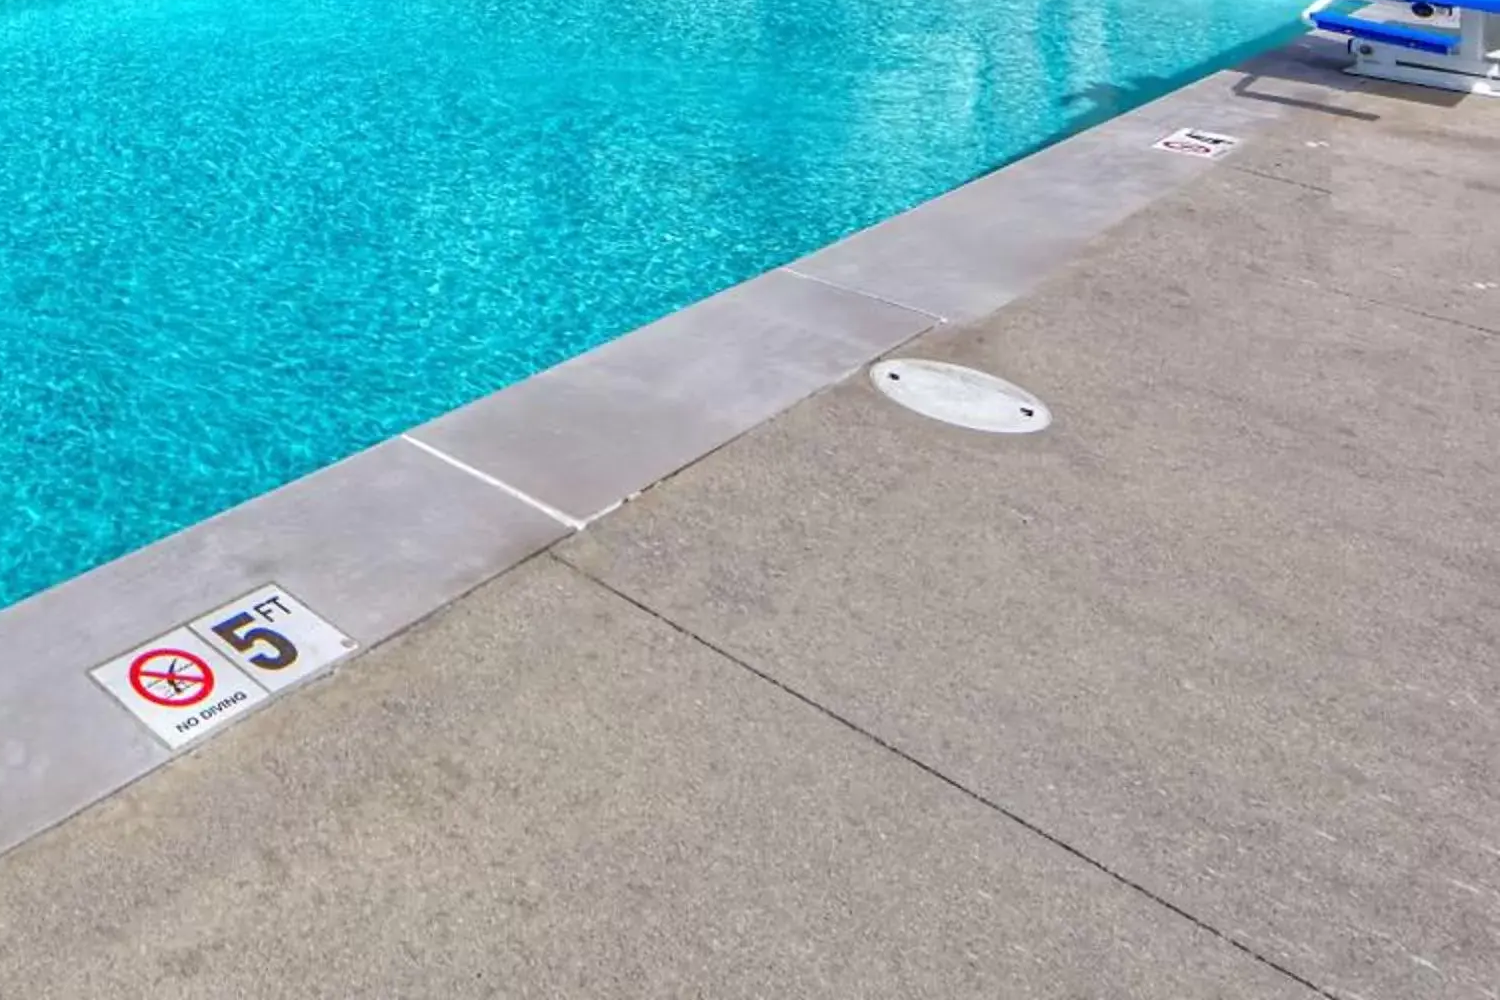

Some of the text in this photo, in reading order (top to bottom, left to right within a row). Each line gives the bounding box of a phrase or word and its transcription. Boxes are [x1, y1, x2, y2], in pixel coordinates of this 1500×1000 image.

[211, 596, 299, 670] 5 FT
[175, 690, 248, 733] NO DIVING
